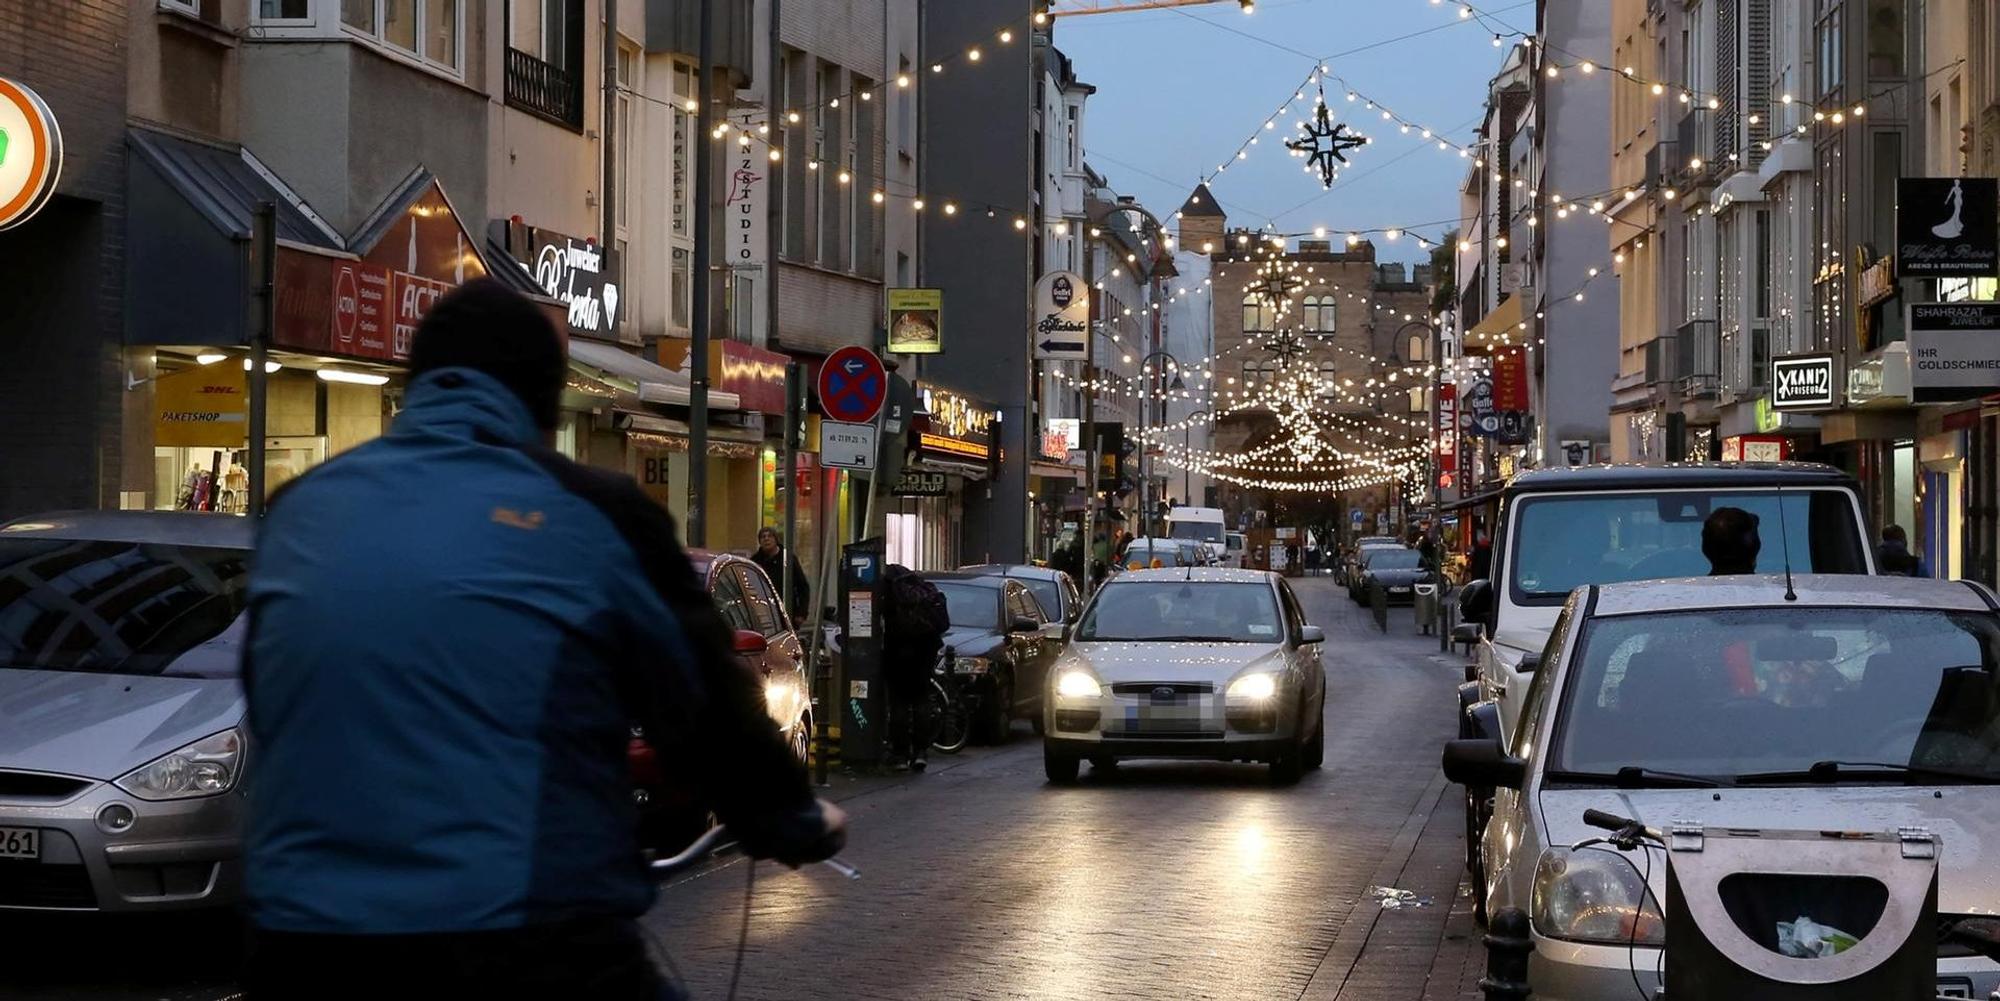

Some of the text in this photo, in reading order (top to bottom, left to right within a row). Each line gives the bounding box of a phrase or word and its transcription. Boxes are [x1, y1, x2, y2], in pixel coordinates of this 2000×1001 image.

[566, 238, 600, 273] Juwelier
[1916, 307, 1984, 318] SHAHRAZAT
[1917, 348, 1938, 358] IHR
[1791, 385, 1819, 395] FRISEUR
[162, 411, 220, 422] PAKETSHOP
[1440, 399, 1453, 456] REWE
